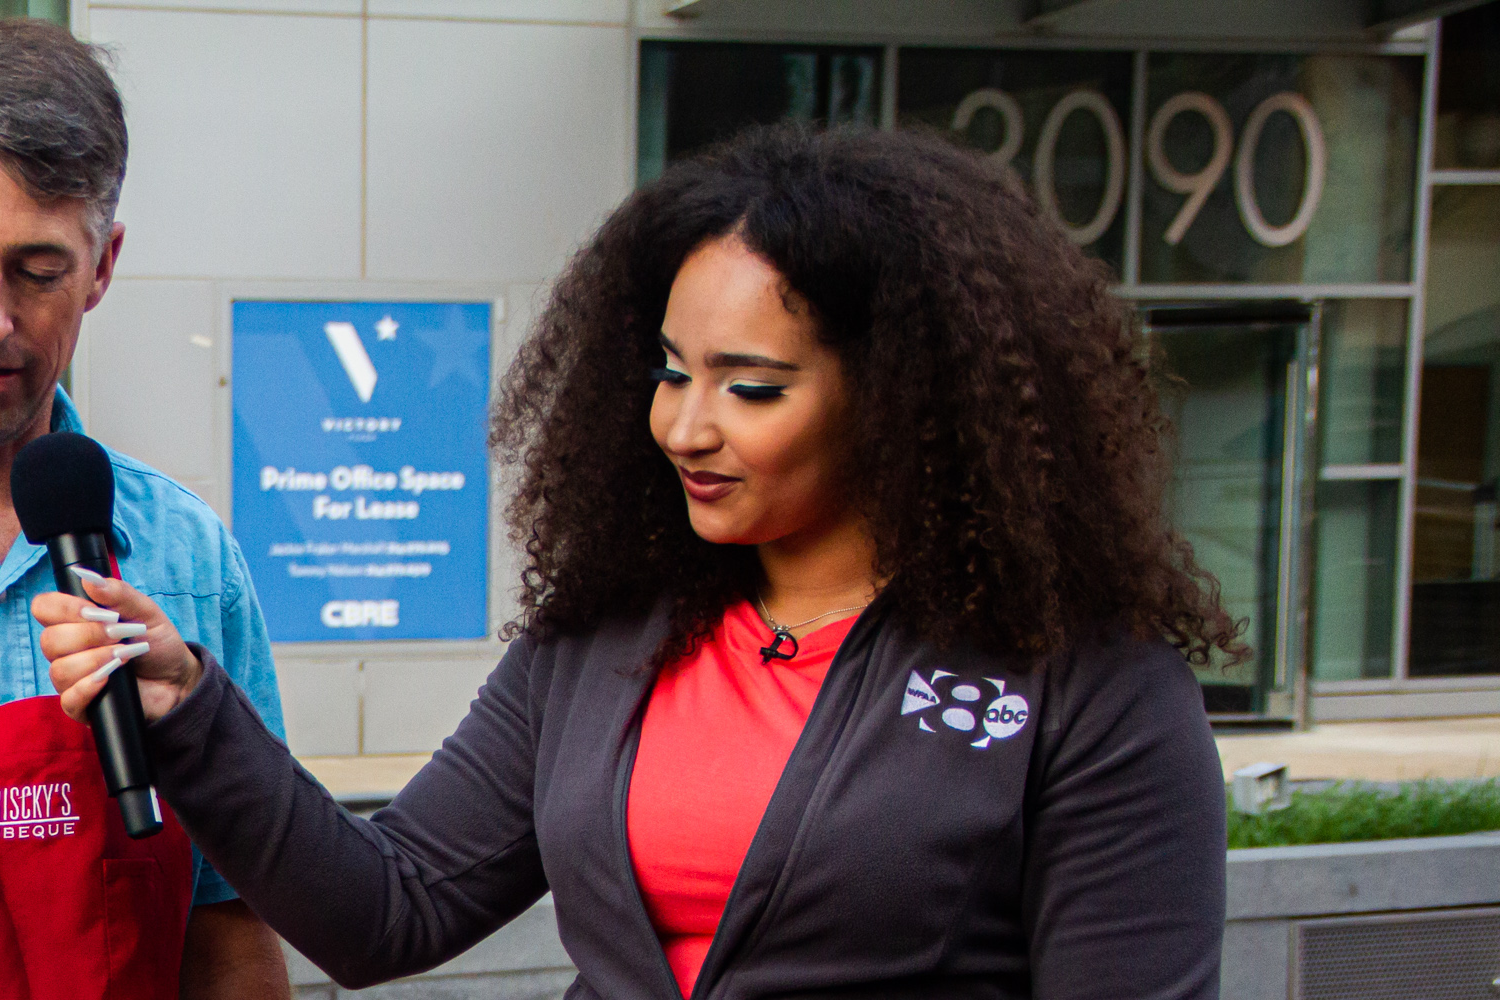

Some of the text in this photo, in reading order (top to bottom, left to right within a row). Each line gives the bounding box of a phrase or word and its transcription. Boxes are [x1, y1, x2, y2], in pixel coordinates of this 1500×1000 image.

[260, 465, 465, 494] Prime Office Space
[313, 496, 419, 519] For Lease
[321, 601, 399, 627] CBRE
[985, 705, 1028, 724] abc
